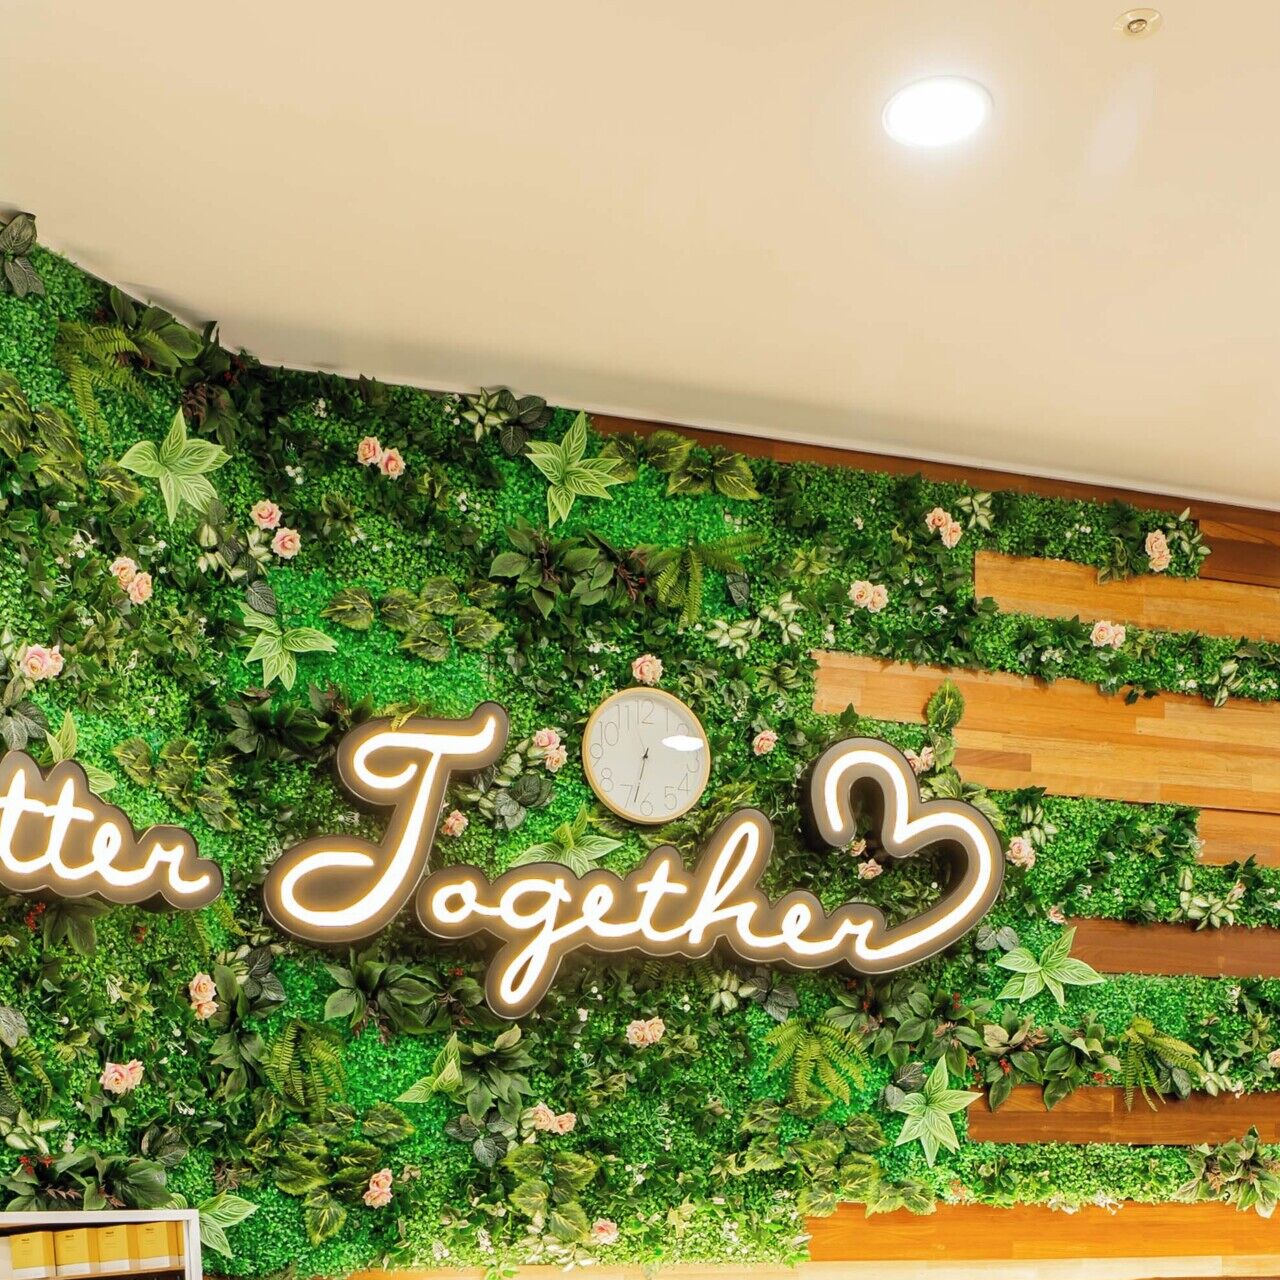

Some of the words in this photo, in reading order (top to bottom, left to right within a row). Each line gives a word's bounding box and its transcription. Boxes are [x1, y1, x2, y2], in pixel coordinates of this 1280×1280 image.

[635, 699, 655, 725] 12
[599, 721, 619, 747] 10
[600, 767, 614, 793] 8
[677, 772, 691, 796] 4
[640, 792, 654, 817] 6
[664, 785, 678, 811] 5
[280, 716, 892, 1006] Together
